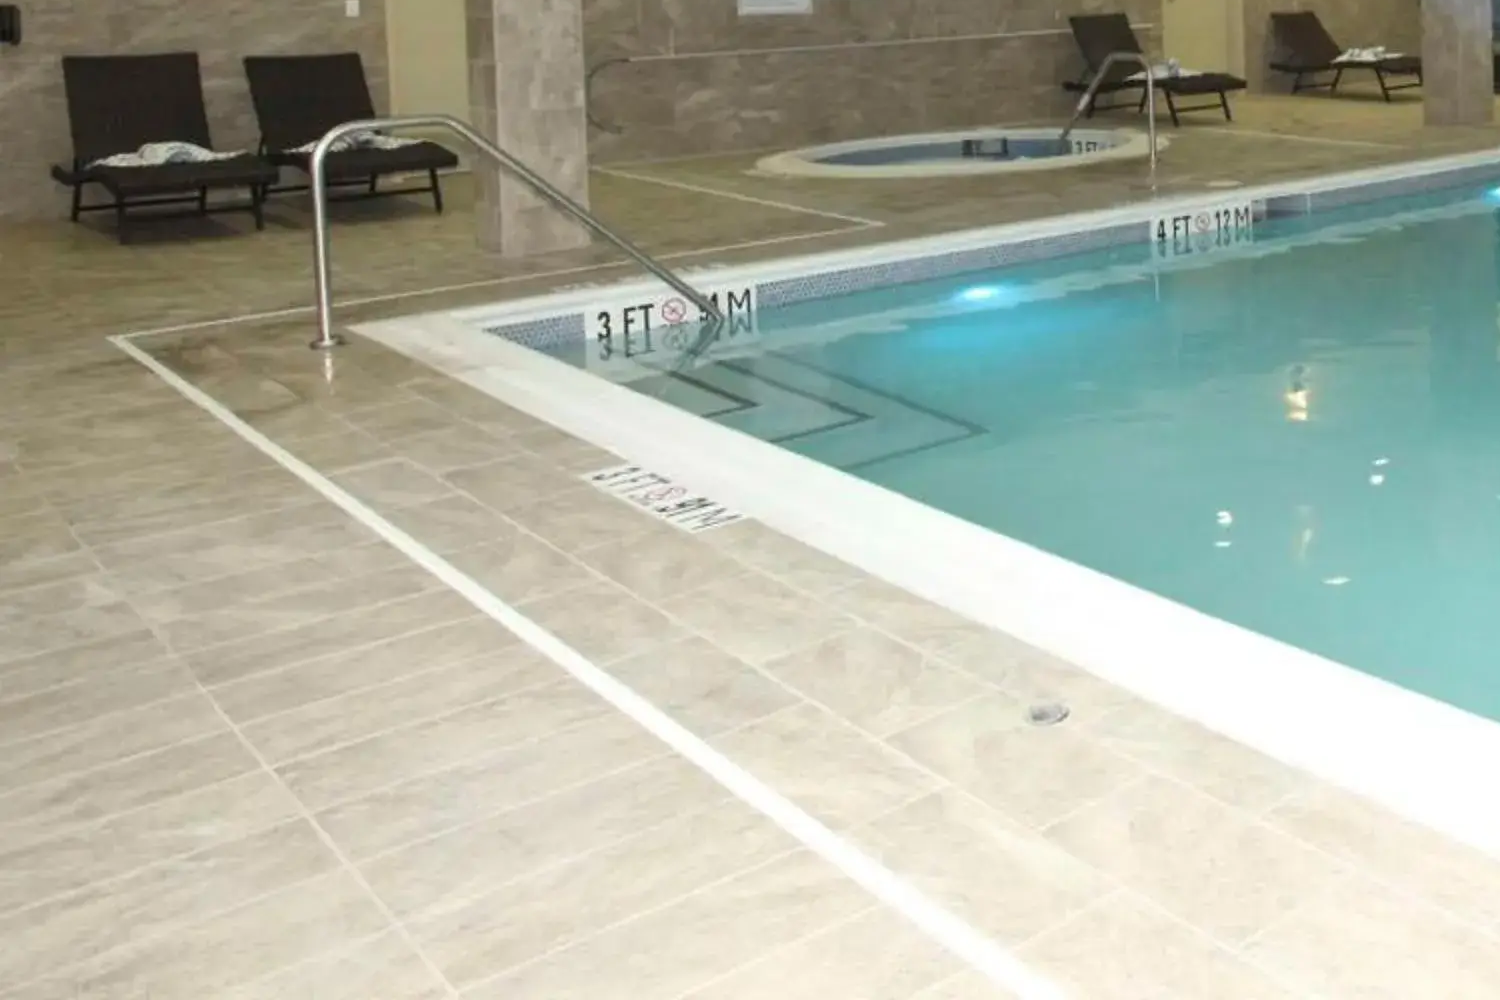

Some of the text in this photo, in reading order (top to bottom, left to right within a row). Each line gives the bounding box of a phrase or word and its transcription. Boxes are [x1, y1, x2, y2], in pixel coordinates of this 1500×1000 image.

[1157, 218, 1167, 239] 4
[1173, 215, 1191, 239] FT
[596, 311, 612, 339] 3
[623, 303, 655, 336] FT
